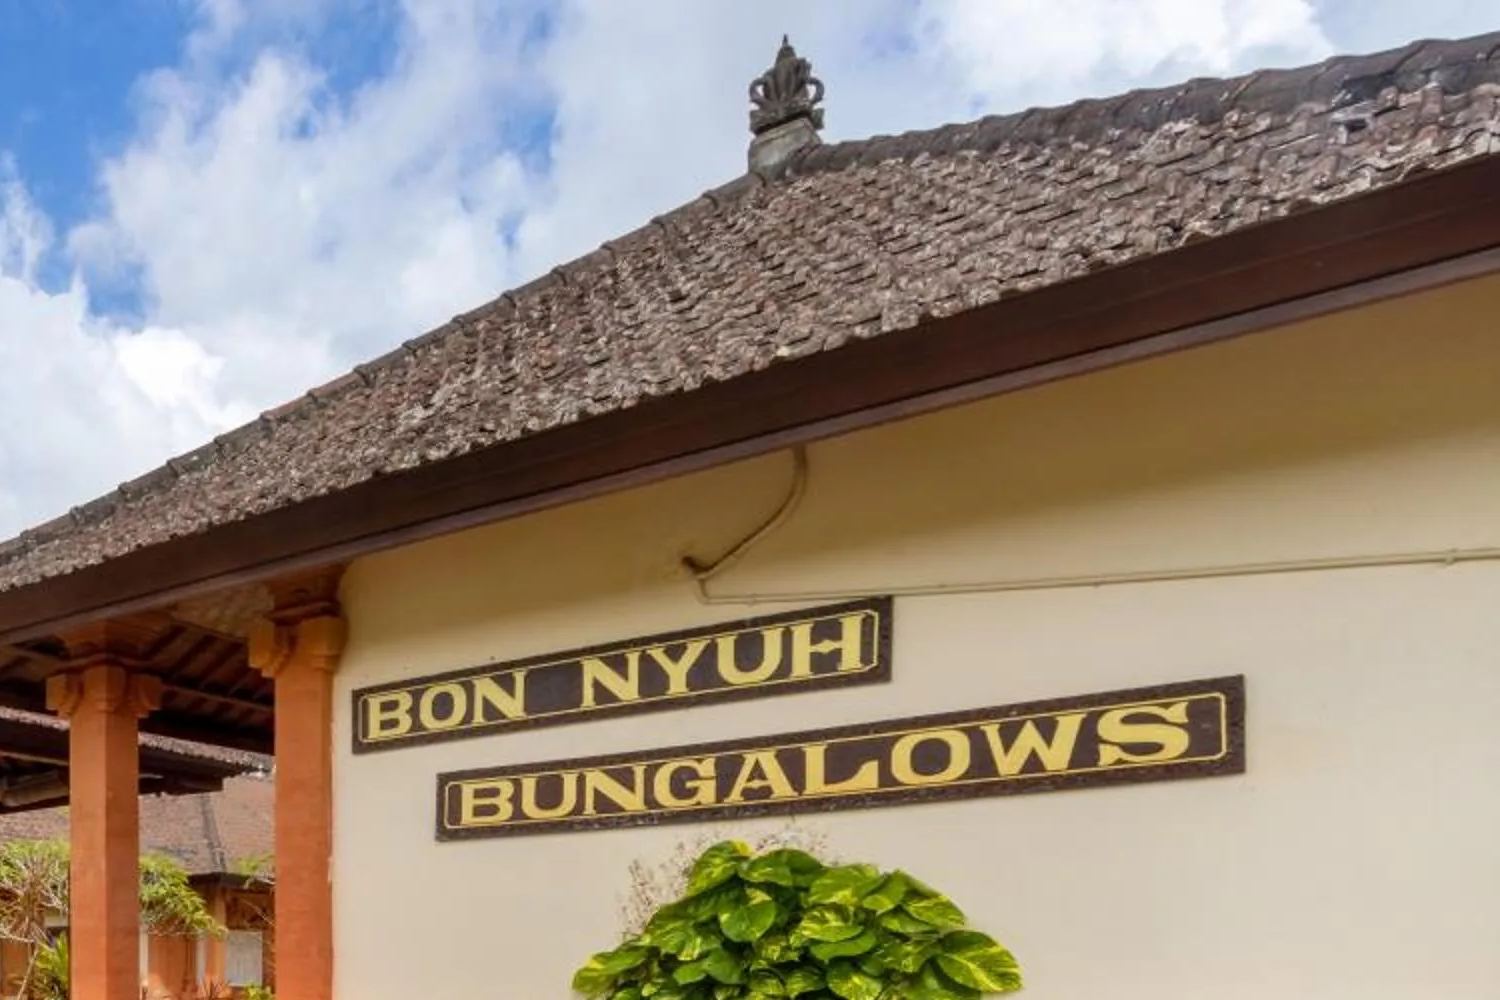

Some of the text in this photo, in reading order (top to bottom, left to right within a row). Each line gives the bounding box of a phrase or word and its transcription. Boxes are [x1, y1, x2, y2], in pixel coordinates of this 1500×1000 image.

[366, 613, 867, 740] BON NYUH
[459, 702, 1192, 827] BUNGALOWS
